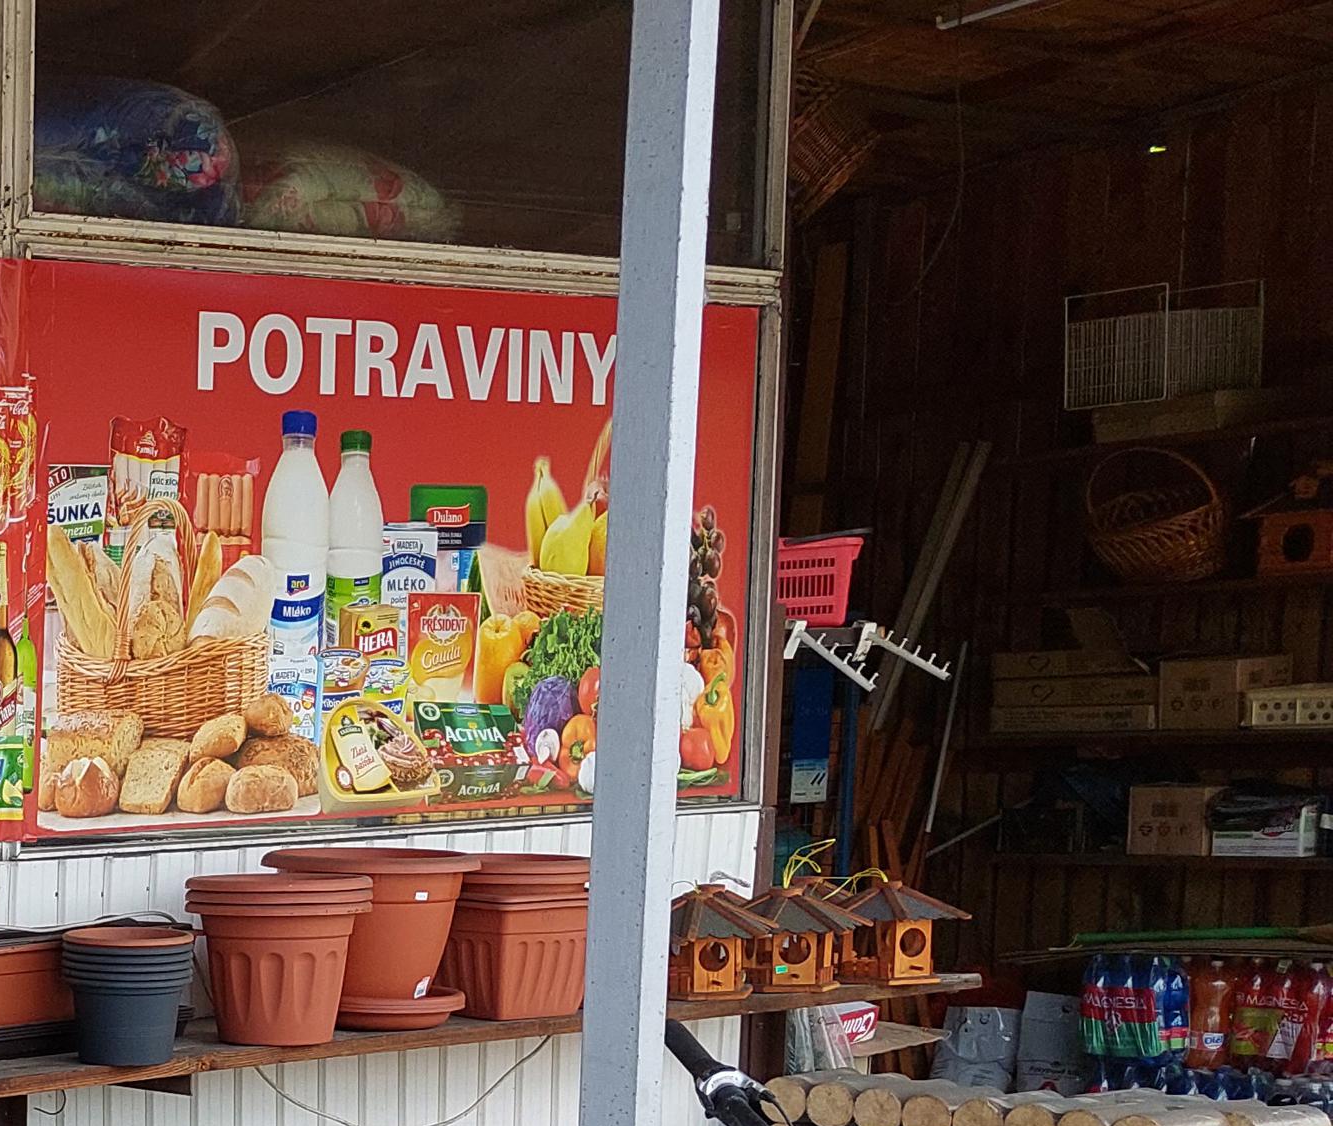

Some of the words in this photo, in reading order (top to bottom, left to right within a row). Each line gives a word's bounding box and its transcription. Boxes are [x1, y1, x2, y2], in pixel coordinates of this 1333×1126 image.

[196, 310, 618, 406] POTRAVINY
[433, 510, 463, 523] Dulano
[290, 578, 306, 590] aro
[386, 576, 427, 592] MLÉKO
[282, 603, 312, 618] Mléko
[421, 615, 468, 634] PRÉSIDENT
[358, 629, 394, 653] HERA
[421, 645, 461, 668] Gouda
[445, 724, 506, 743] ACTIVIA
